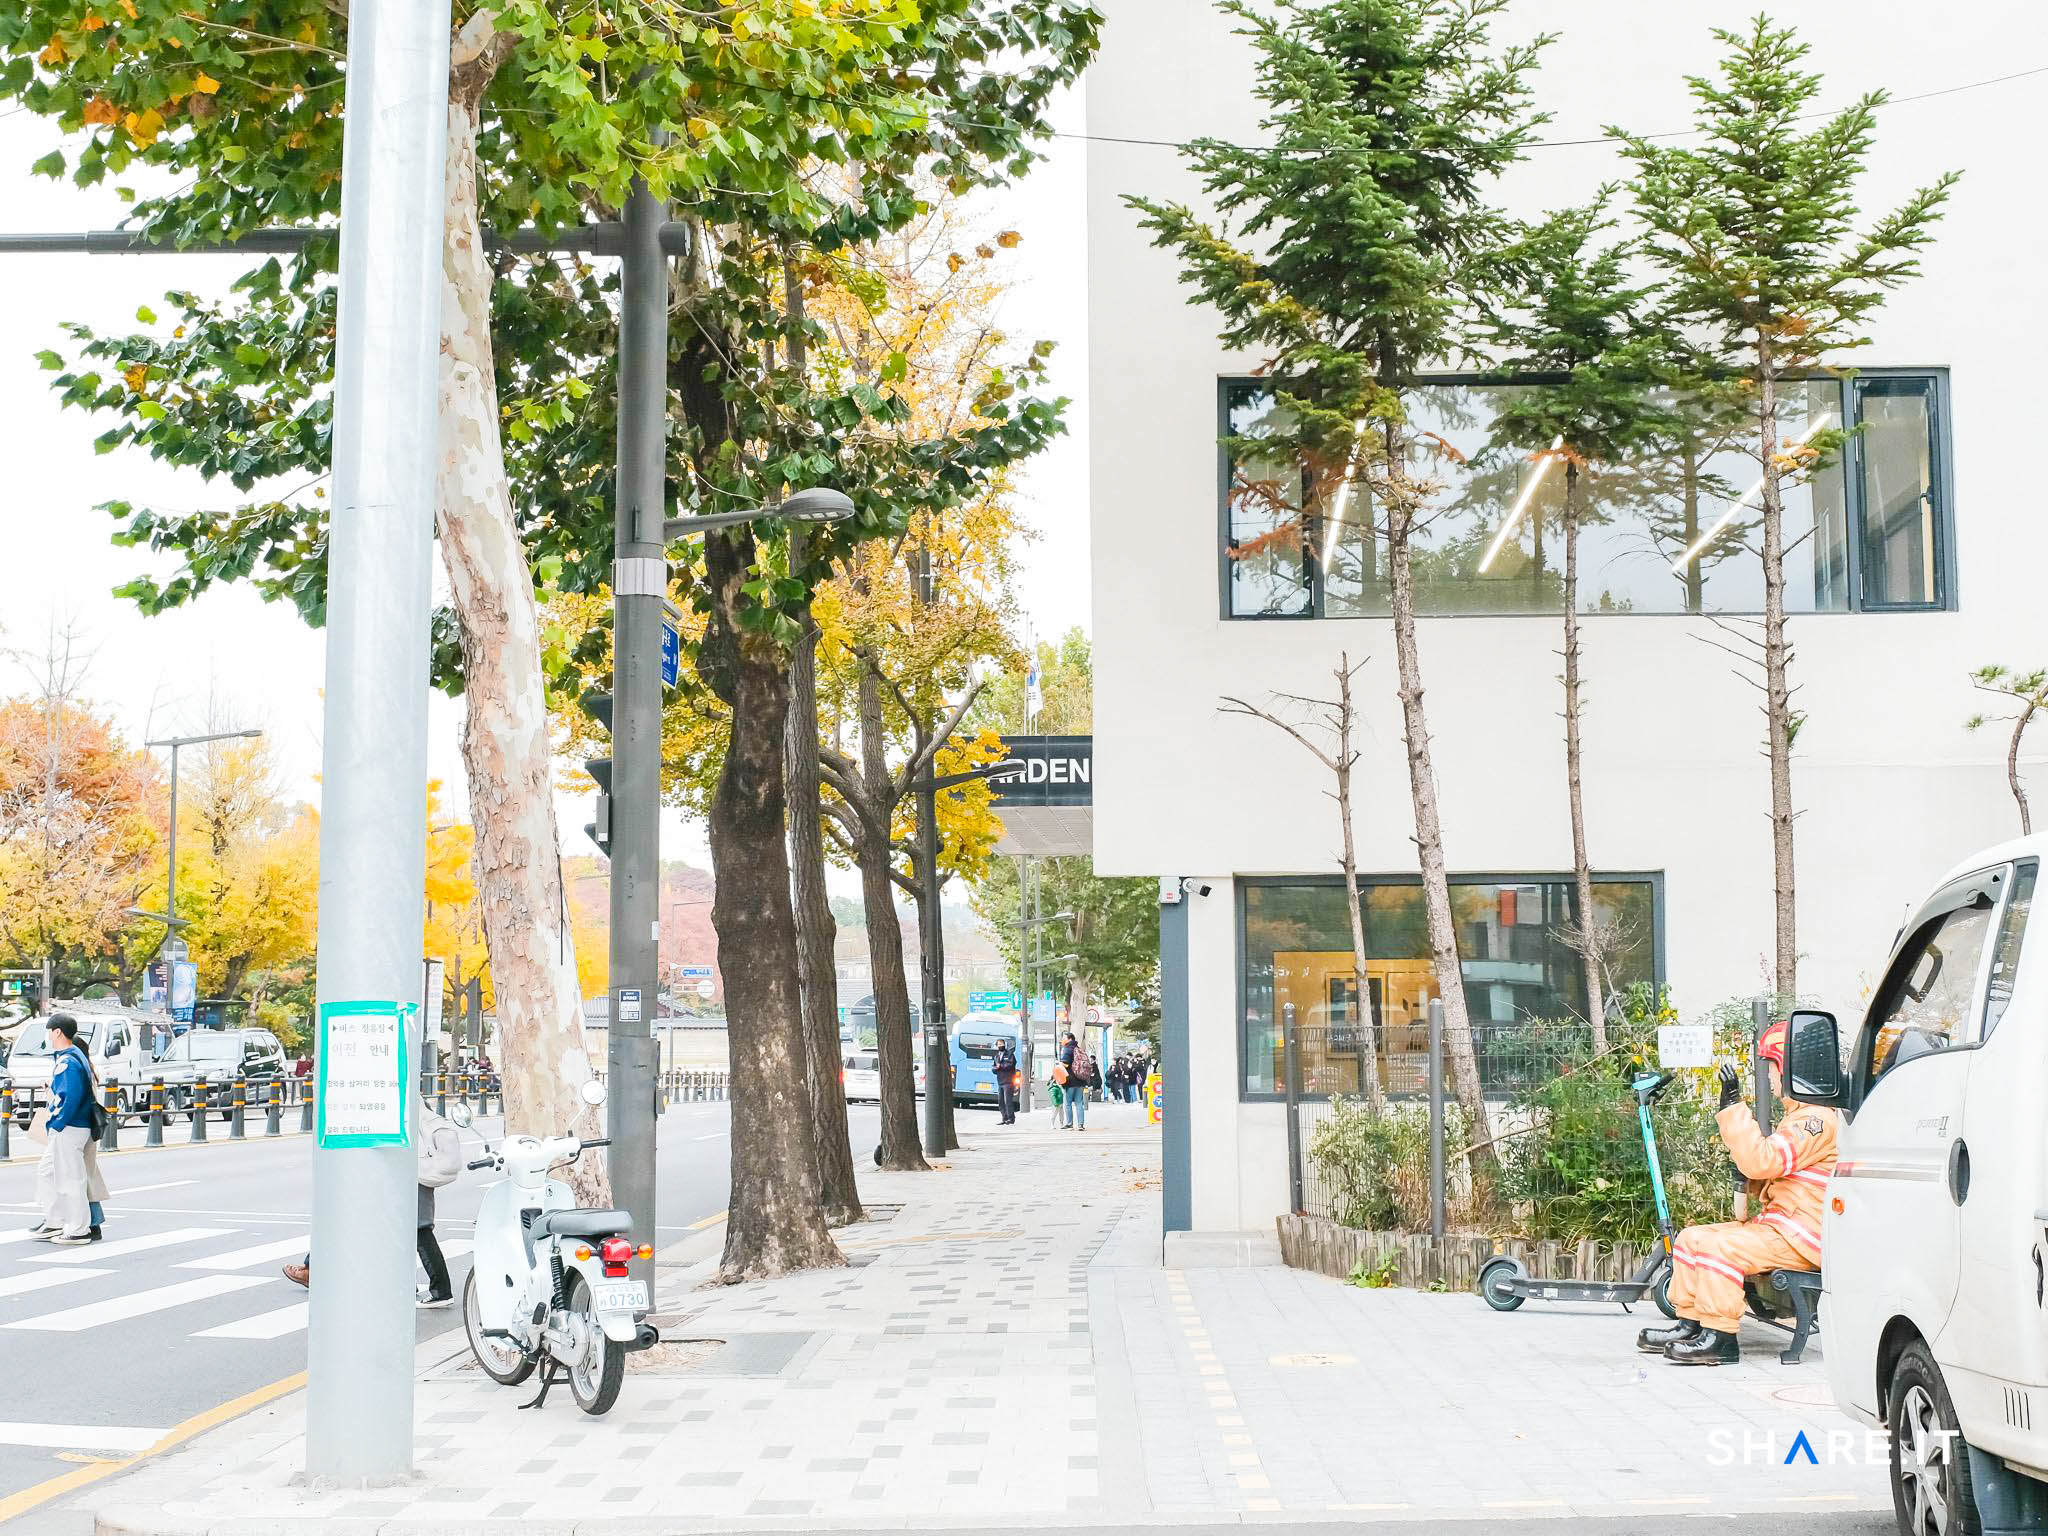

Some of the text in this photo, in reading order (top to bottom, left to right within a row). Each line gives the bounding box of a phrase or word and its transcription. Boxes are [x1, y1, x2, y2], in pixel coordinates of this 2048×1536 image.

[339, 1023, 386, 1034] 버스 정류장
[332, 1041, 389, 1057] 이전 안내
[609, 1293, 644, 1306] 0730
